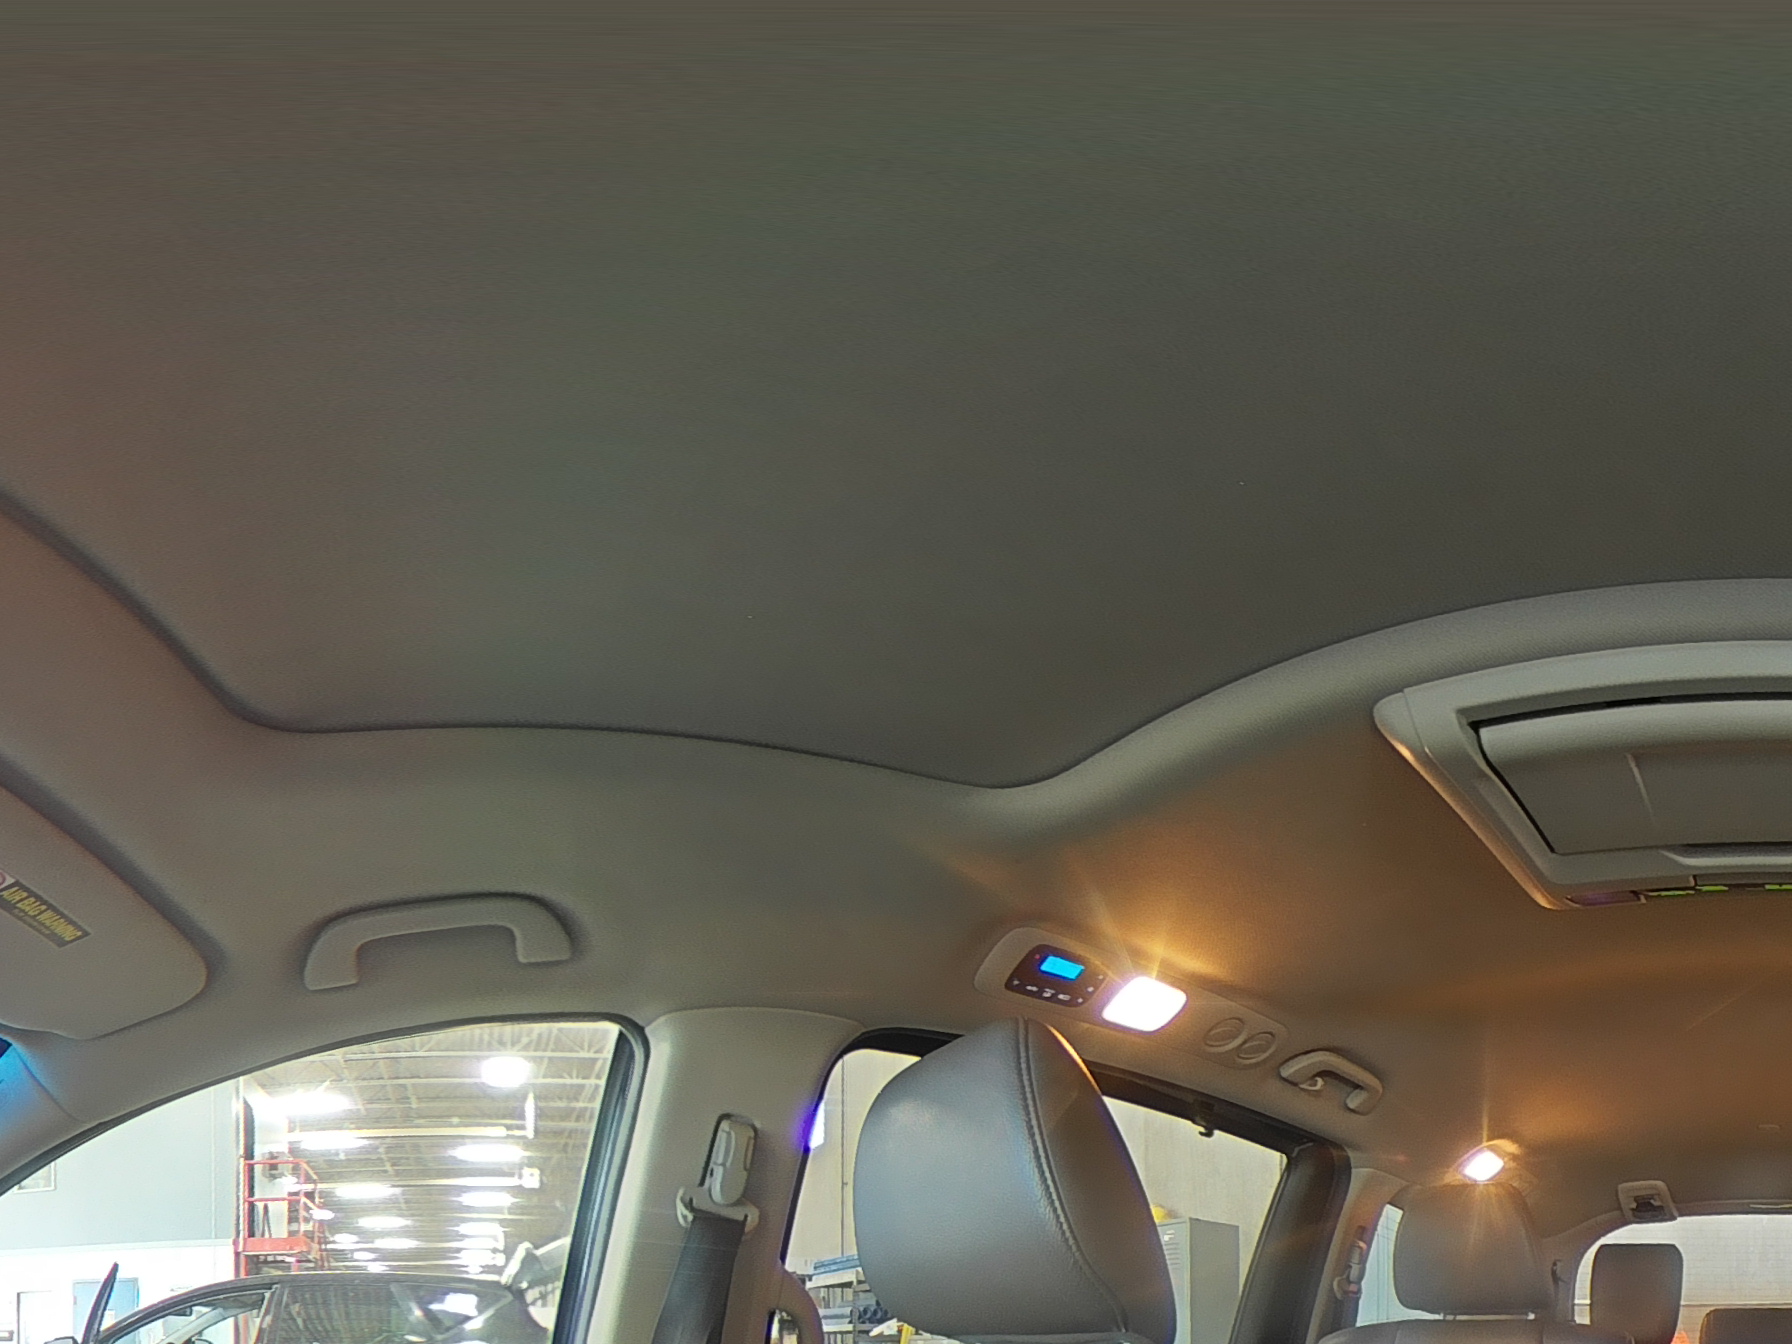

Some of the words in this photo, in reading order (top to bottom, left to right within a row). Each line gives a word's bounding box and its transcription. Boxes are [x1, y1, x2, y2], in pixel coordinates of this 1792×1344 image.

[0, 886, 20, 904] AIR
[16, 897, 47, 916] BAG
[36, 909, 83, 942] WARNING
